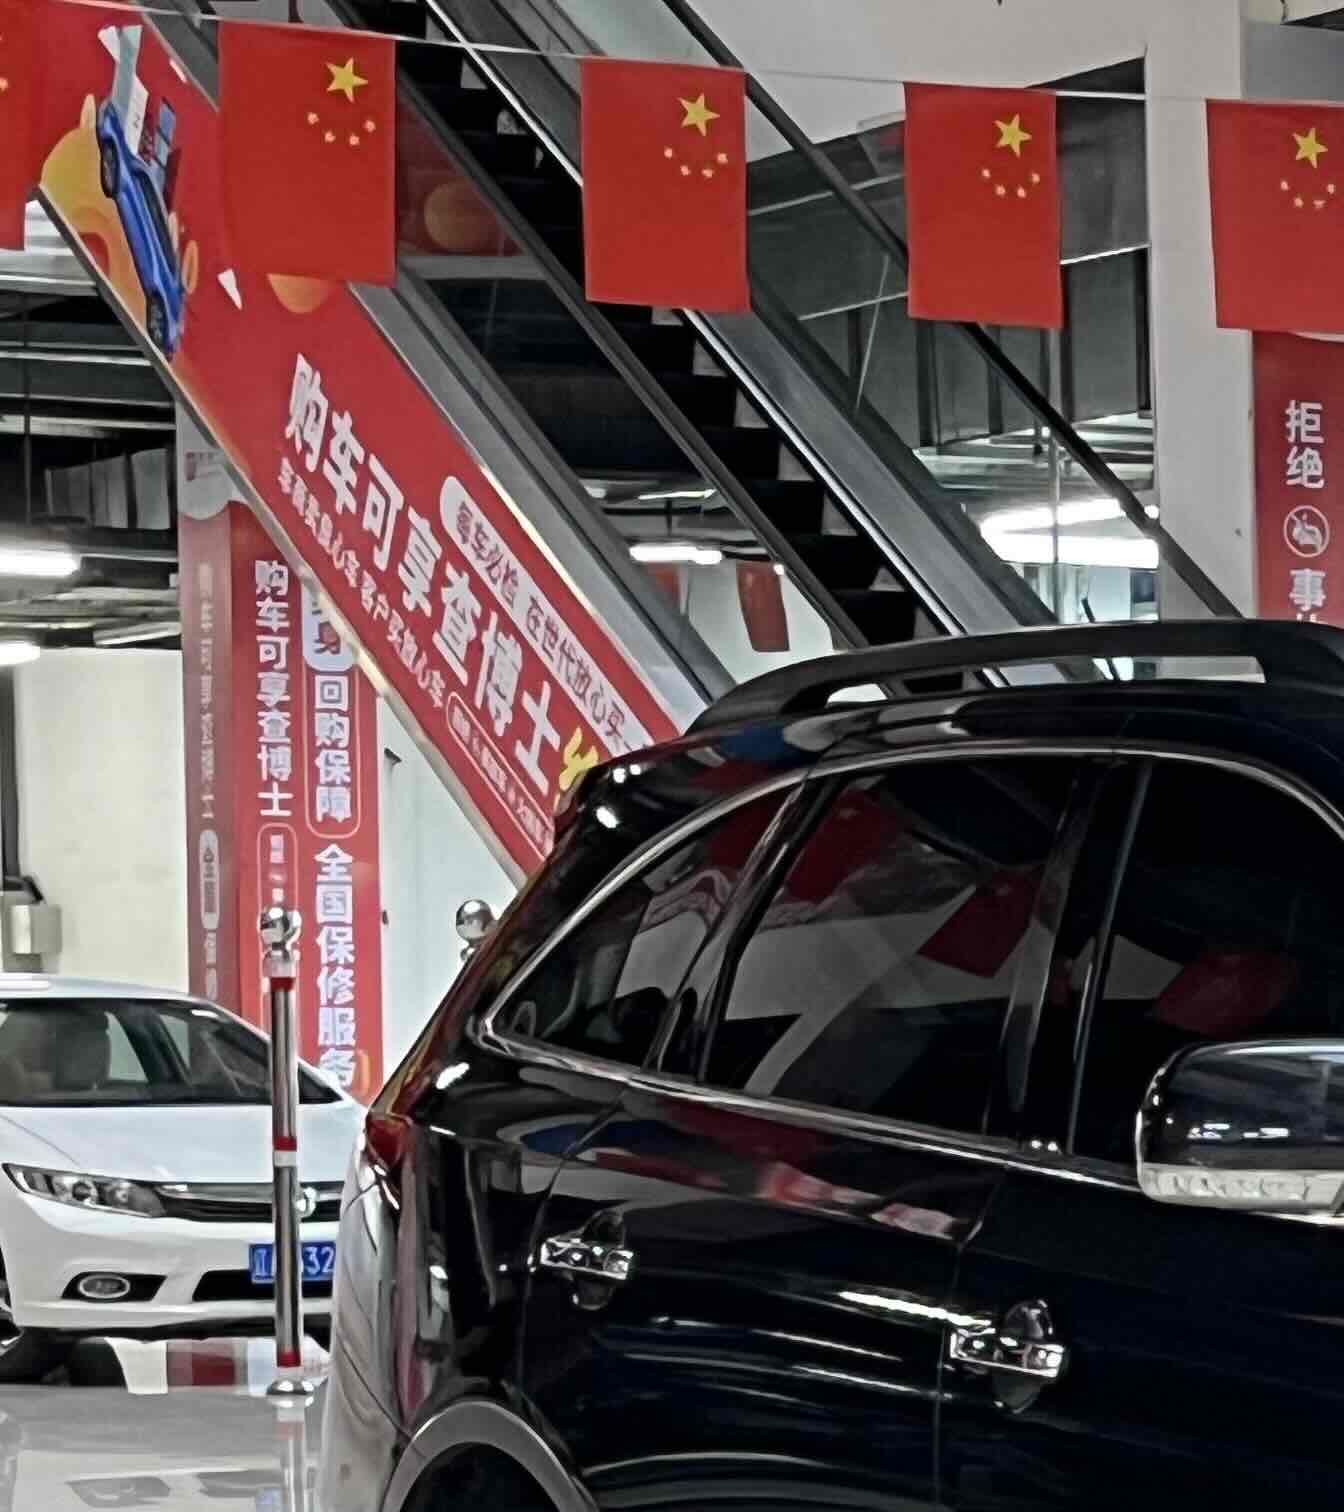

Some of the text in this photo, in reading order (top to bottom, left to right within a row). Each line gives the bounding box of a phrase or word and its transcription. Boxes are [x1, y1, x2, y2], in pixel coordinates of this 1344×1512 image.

[1286, 400, 1325, 489] 拒绝
[285, 352, 560, 796] 购车可享查博士
[254, 559, 294, 816] 购车可享查博士
[313, 674, 353, 823] 回购保障
